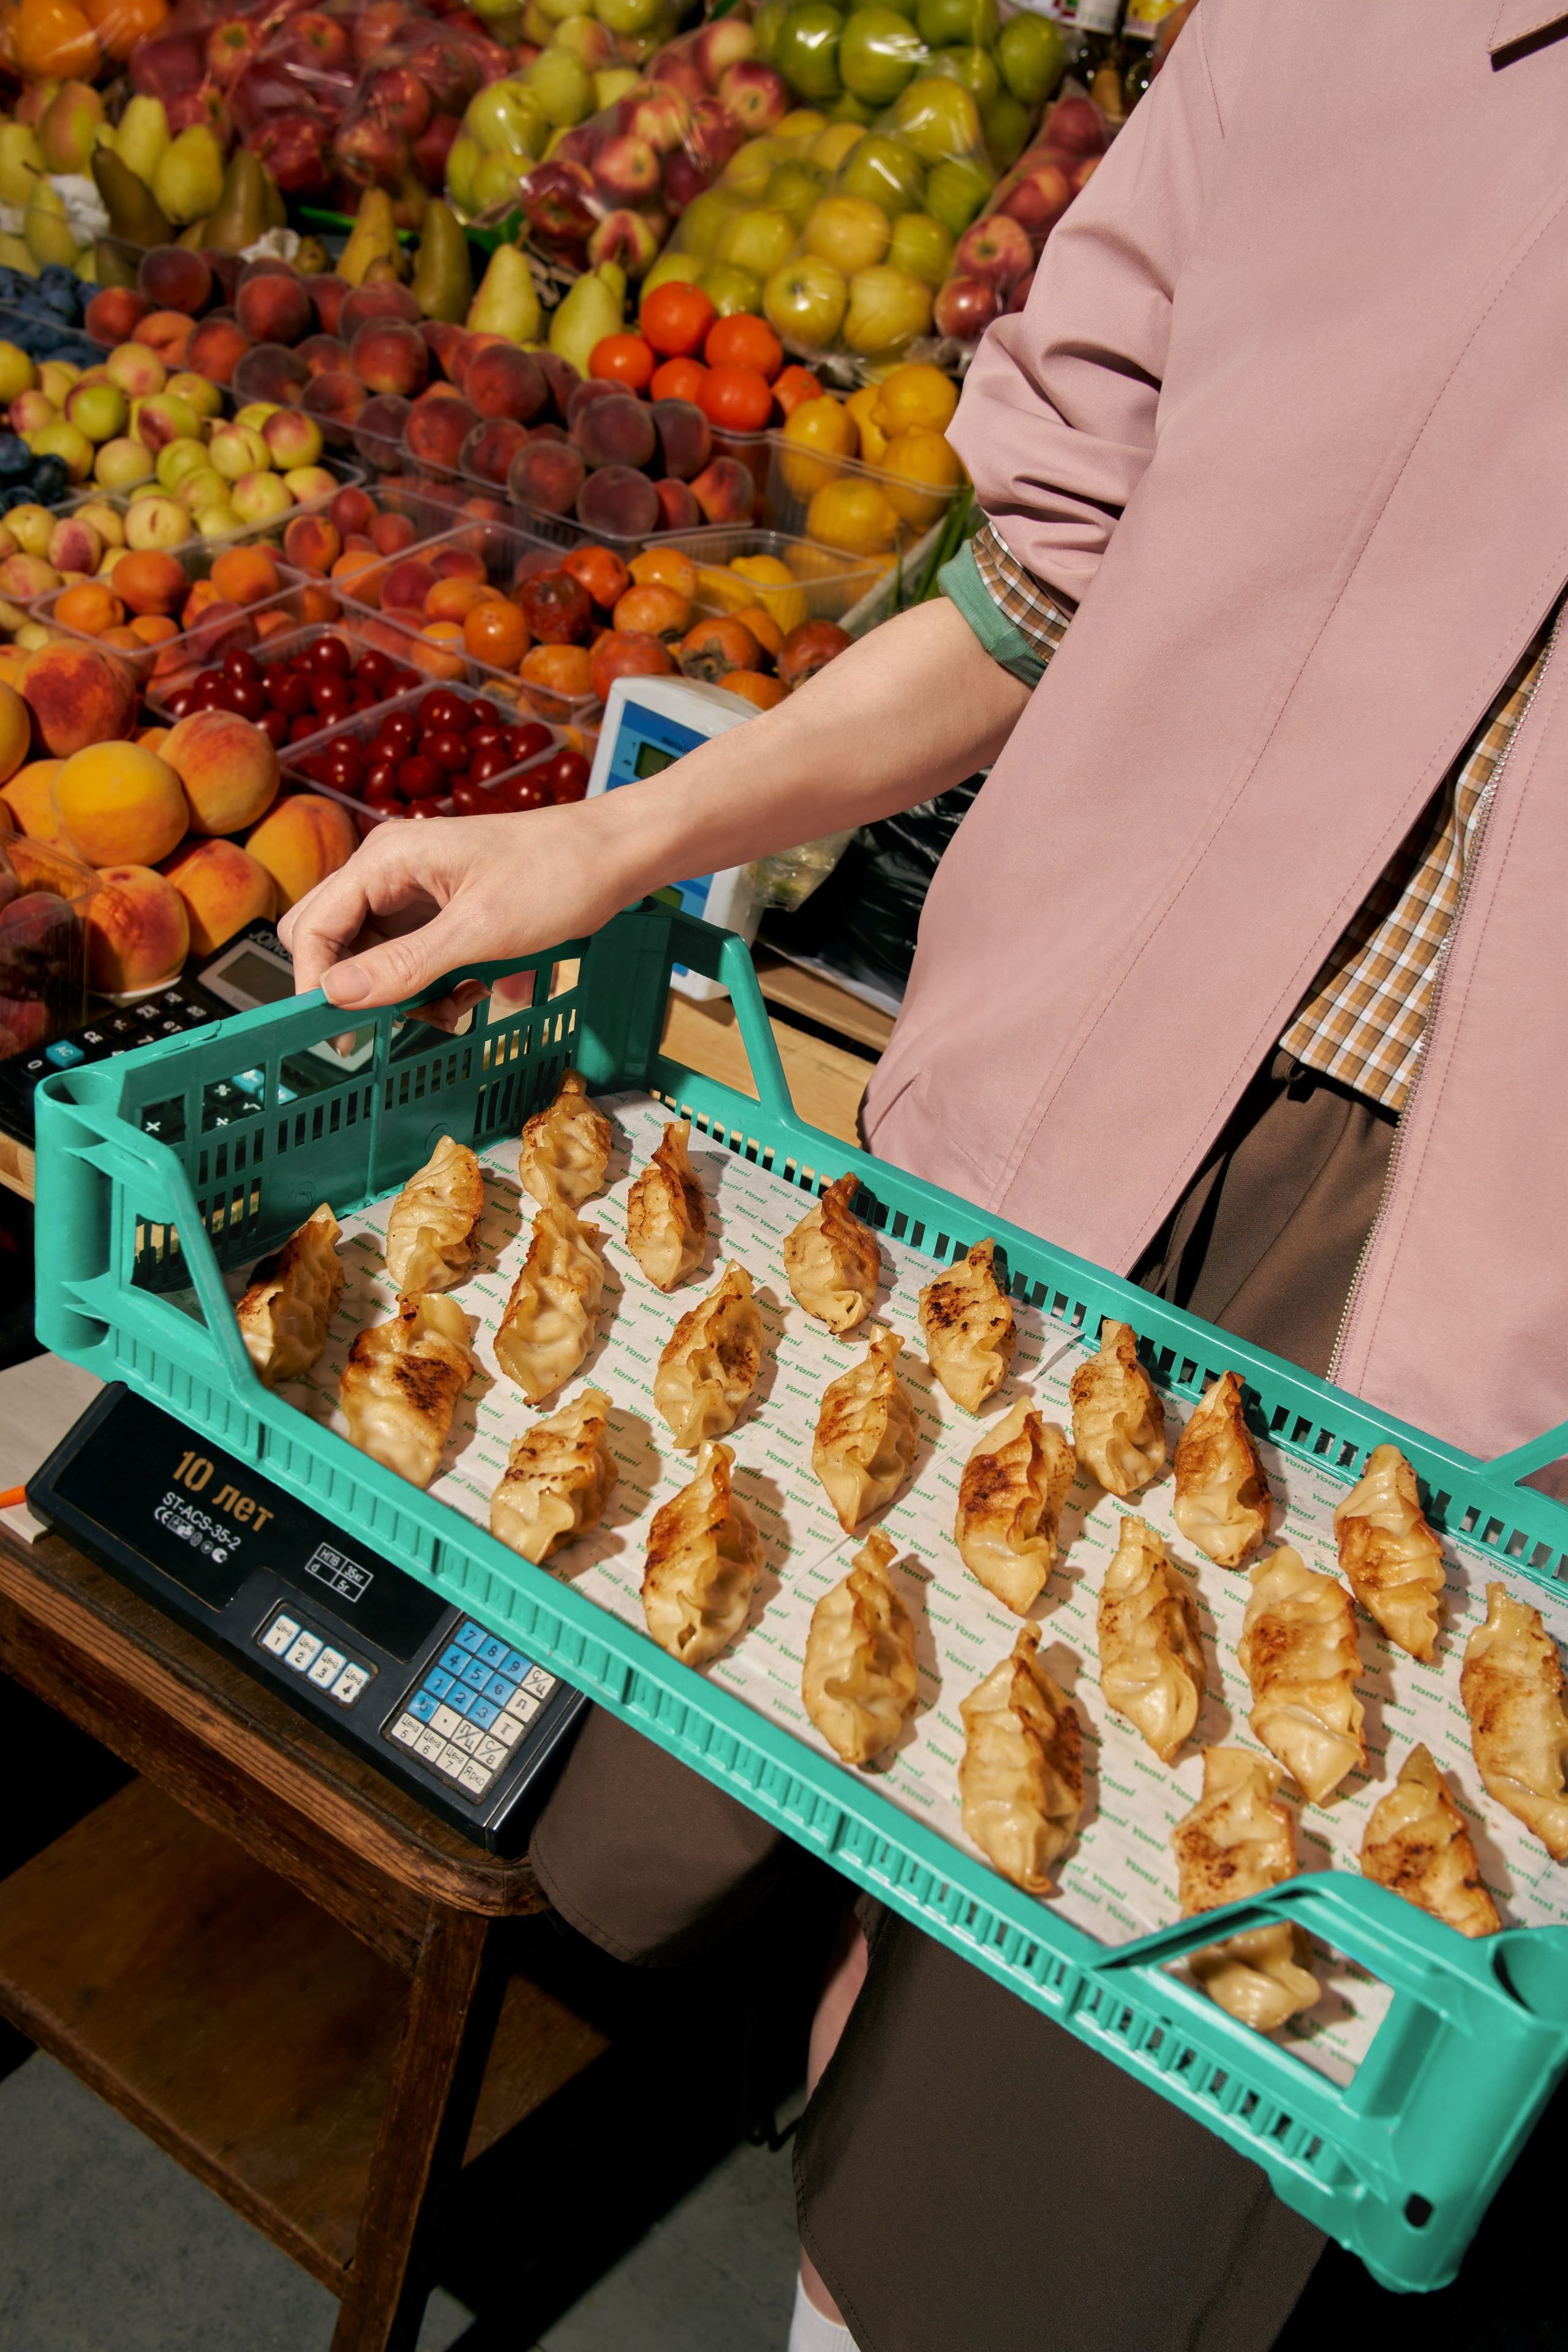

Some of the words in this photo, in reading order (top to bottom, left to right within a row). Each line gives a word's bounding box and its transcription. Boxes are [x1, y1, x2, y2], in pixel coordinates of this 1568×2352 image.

[162, 1020, 184, 1033] GT
[83, 1031, 104, 1044] CE
[137, 1035, 154, 1044] 7
[55, 1046, 74, 1058] AC
[27, 1059, 43, 1070] 0
[616, 1121, 641, 1138] Yami
[491, 1161, 514, 1175] Yami
[705, 1150, 727, 1166] Yami
[728, 1164, 752, 1177] Yami
[481, 1177, 502, 1189] Yami
[503, 1188, 527, 1205] Yami
[720, 1180, 742, 1191] Yami
[744, 1190, 767, 1204] Yami
[769, 1185, 793, 1199] Yami
[490, 1200, 514, 1216] Yami
[597, 1210, 620, 1227] Yami
[709, 1211, 734, 1225] Yami
[735, 1205, 758, 1219] Yami
[760, 1218, 783, 1234] Yami
[503, 1228, 527, 1243] Yami
[752, 1234, 774, 1250] Yami
[349, 1237, 375, 1253] Yami
[725, 1238, 750, 1253] Yami
[880, 1262, 904, 1276] Yami
[904, 1256, 927, 1270] Yami
[360, 1267, 383, 1282] Yami
[486, 1264, 511, 1280] Yami
[473, 1281, 498, 1298] Yami
[624, 1273, 647, 1288] Yami
[649, 1286, 674, 1300] Yami
[442, 1291, 467, 1305] Yami
[369, 1298, 396, 1315] Yami
[639, 1302, 663, 1318] Yami
[758, 1299, 783, 1315] Yami
[891, 1306, 918, 1320] Yami
[337, 1308, 363, 1324] Yami
[609, 1313, 636, 1327] Yami
[1023, 1330, 1050, 1341] Yami
[1049, 1322, 1074, 1335] Yami
[775, 1332, 802, 1348] Yami
[805, 1324, 833, 1338] Yami
[834, 1335, 858, 1352] Yami
[598, 1332, 623, 1346] Yami
[624, 1345, 651, 1363] Yami
[767, 1350, 792, 1365] Yami
[795, 1364, 821, 1379] Yami
[823, 1354, 850, 1370] Yami
[1019, 1352, 1045, 1364] Yami
[613, 1366, 638, 1384] Yami
[786, 1384, 812, 1399] Yami
[906, 1378, 933, 1395] Yami
[756, 1395, 783, 1409] Yami
[1042, 1393, 1069, 1408] Yami
[1156, 1389, 1182, 1405] Yami
[477, 1401, 503, 1419] Yami
[629, 1406, 655, 1423] Yami
[462, 1421, 489, 1437] Yami
[748, 1415, 774, 1429] Yami
[927, 1413, 954, 1431] Yami
[646, 1441, 673, 1458] Yami
[921, 1434, 947, 1450] Yami
[478, 1453, 505, 1469] Yami
[614, 1450, 641, 1467] Yami
[766, 1450, 793, 1467] Yami
[734, 1461, 763, 1479] Yami
[1285, 1457, 1313, 1473] Yami
[1316, 1472, 1343, 1490] Yami
[173, 1450, 214, 1492] 10
[211, 1484, 275, 1532] лет
[631, 1484, 660, 1500] Yami
[786, 1490, 814, 1507] Yami
[618, 1503, 647, 1520] Yami
[754, 1499, 783, 1517] Yami
[1288, 1503, 1316, 1520] Yami
[162, 1491, 241, 1551] ST-ACS-35-2
[1085, 1513, 1112, 1529] Yami
[807, 1528, 834, 1544] Yami
[1078, 1531, 1106, 1548] Yami
[1284, 1524, 1313, 1541] Yami
[776, 1538, 805, 1556] Yami
[909, 1540, 938, 1559] Yami
[319, 1547, 341, 1567] НПВ
[1455, 1543, 1485, 1562] Yami
[1488, 1560, 1518, 1580] Yami
[311, 1562, 318, 1573] d
[765, 1561, 794, 1581] Yami
[336, 1578, 350, 1593] 5г
[899, 1562, 927, 1583] Yami
[932, 1580, 961, 1600] Yami
[1544, 1591, 1568, 1608] Yam
[1058, 1599, 1086, 1618] Yami
[1197, 1601, 1225, 1618] Yami
[276, 1621, 295, 1637] Цена
[922, 1605, 951, 1625] Yami
[954, 1623, 985, 1645] Yami
[986, 1613, 1016, 1631] Yami
[463, 1631, 477, 1642] 7
[1050, 1621, 1079, 1643] Yami
[274, 1637, 281, 1646] 1
[298, 1636, 317, 1653] Цена
[295, 1652, 304, 1664] 2
[488, 1645, 497, 1657] 8
[1376, 1643, 1408, 1660] Yami
[321, 1651, 339, 1668] Цена
[449, 1654, 461, 1667] 4
[945, 1651, 975, 1672] Yami
[344, 1668, 363, 1686] Цена
[471, 1668, 483, 1679] 5
[342, 1684, 353, 1695] 4
[434, 1678, 442, 1689] 1
[494, 1684, 504, 1695] 6
[455, 1692, 466, 1704] 2
[1411, 1683, 1444, 1702] Yami
[475, 1707, 489, 1718] 3
[1383, 1697, 1415, 1716] Yami
[402, 1716, 420, 1733] Цена
[1104, 1714, 1134, 1735] Yami
[399, 1730, 407, 1739] 5
[423, 1730, 442, 1749] Цена
[1382, 1722, 1414, 1744] Yami
[423, 1745, 429, 1755] 6
[445, 1746, 465, 1765] Цена
[445, 1761, 454, 1770] 7
[463, 1764, 485, 1786] Ярко
